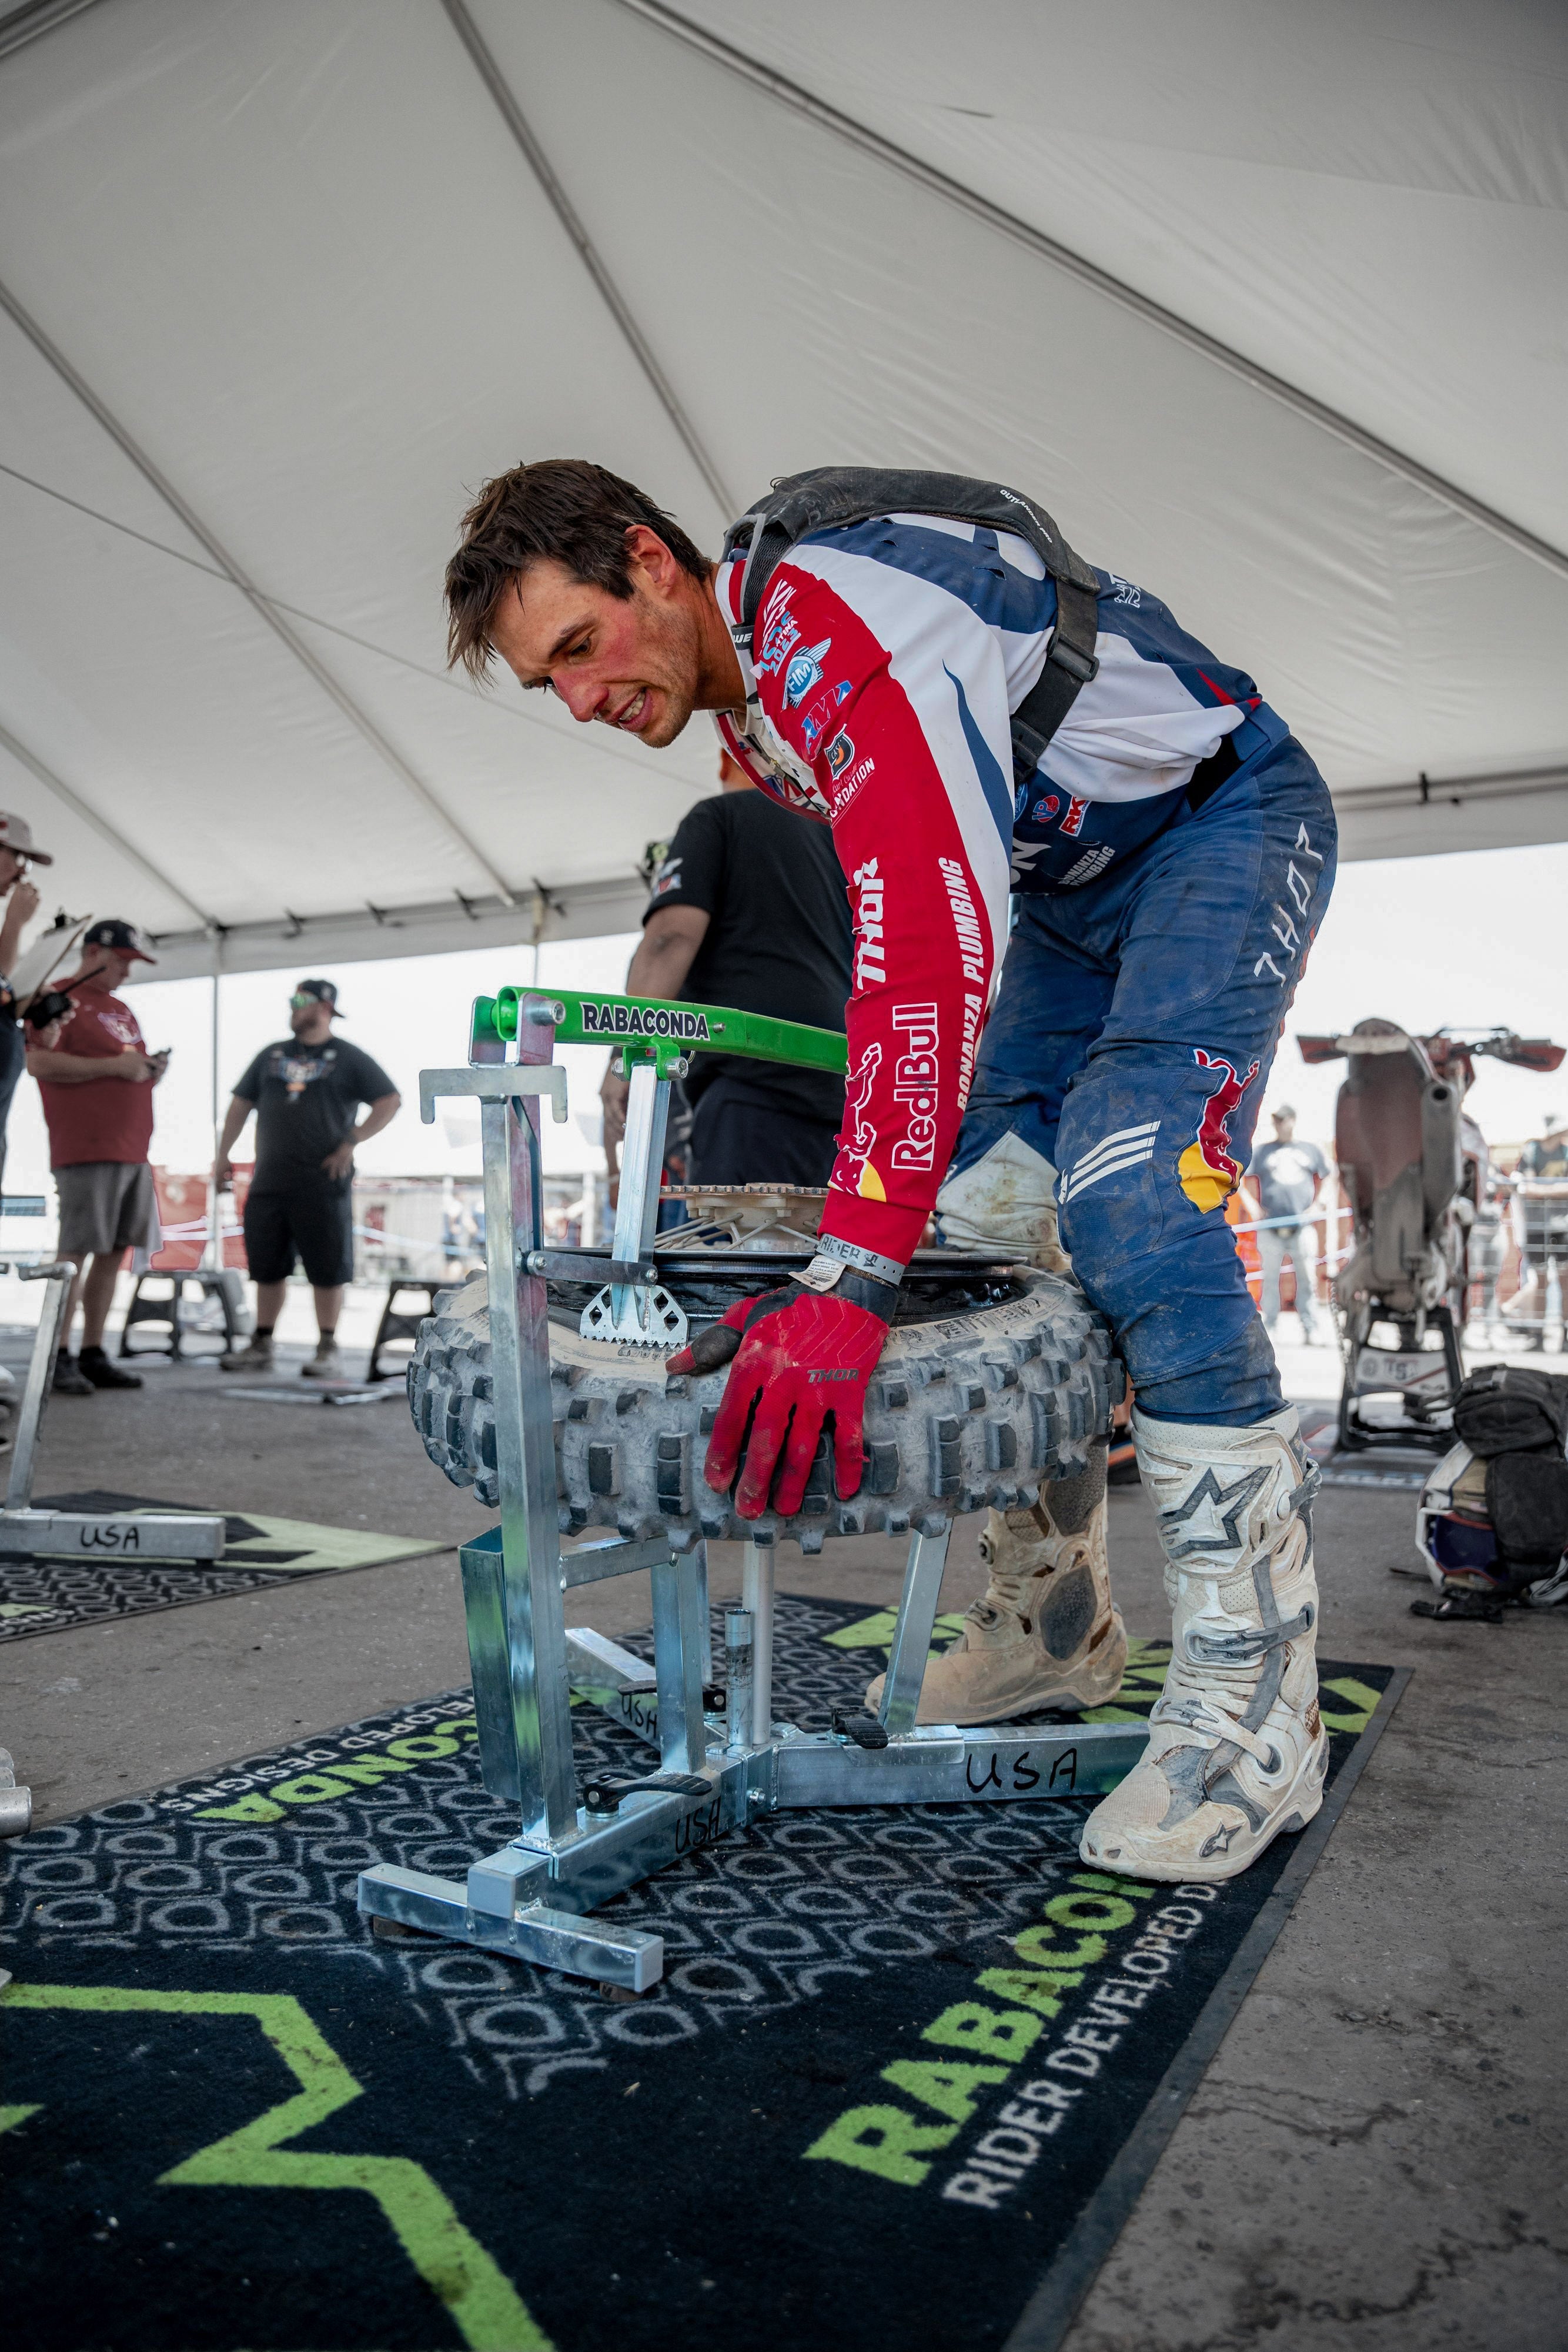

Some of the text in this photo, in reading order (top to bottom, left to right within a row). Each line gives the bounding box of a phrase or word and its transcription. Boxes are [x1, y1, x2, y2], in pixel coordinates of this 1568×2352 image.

[999, 489, 1052, 543] OUTLANDER PRO
[770, 627, 799, 672] 2023
[788, 663, 811, 692] FIM
[1032, 800, 1057, 821] VP
[1061, 796, 1088, 834] RK
[1074, 812, 1084, 835] TAKASAGO
[1069, 846, 1116, 886] PLUMBING
[853, 857, 886, 990] THOR
[938, 857, 984, 1112] BONANZA PLUMBING
[581, 1003, 710, 1040] RABACONDA
[807, 1368, 859, 1383] THOR
[80, 1526, 140, 1550] USA
[159, 1749, 340, 1812] DESIGNS
[965, 1748, 1078, 1793] USA
[676, 1798, 721, 1854] USA
[943, 1905, 1203, 2209] RIDER DEVELOPED
